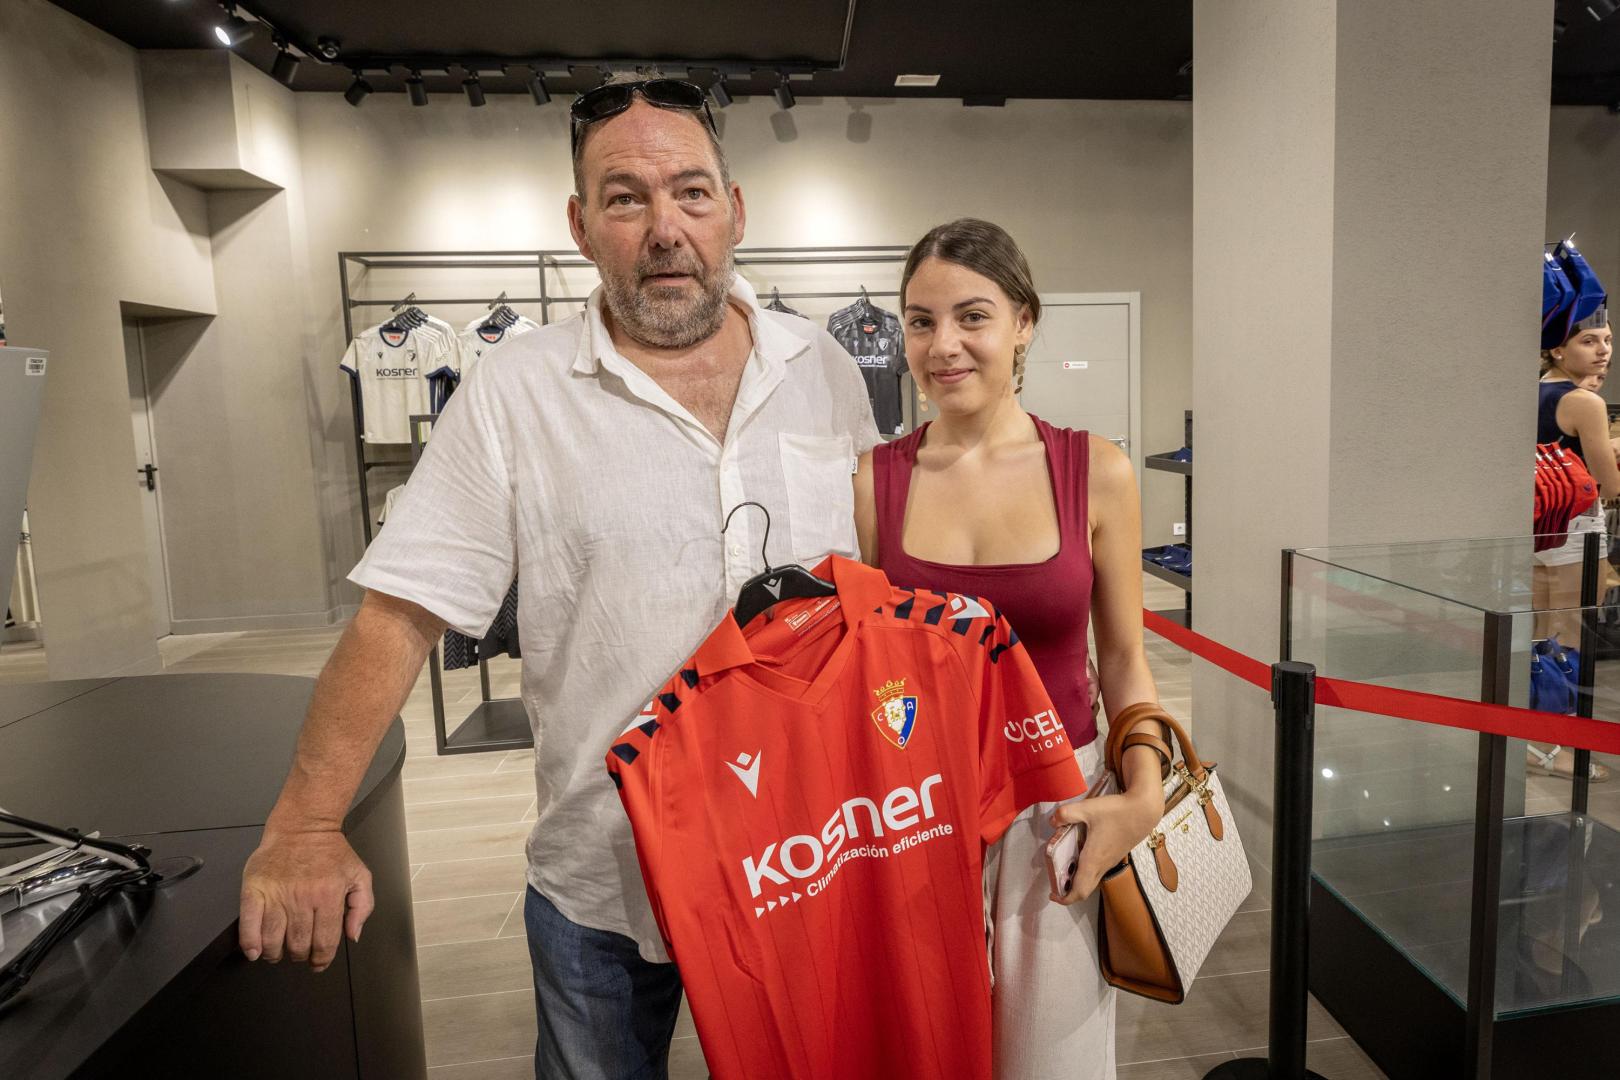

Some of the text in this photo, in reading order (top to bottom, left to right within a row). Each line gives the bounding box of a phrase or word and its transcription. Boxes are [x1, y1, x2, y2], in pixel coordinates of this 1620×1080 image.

[1030, 731, 1067, 753] LIGH
[806, 823, 953, 897] Climatización eficiente
